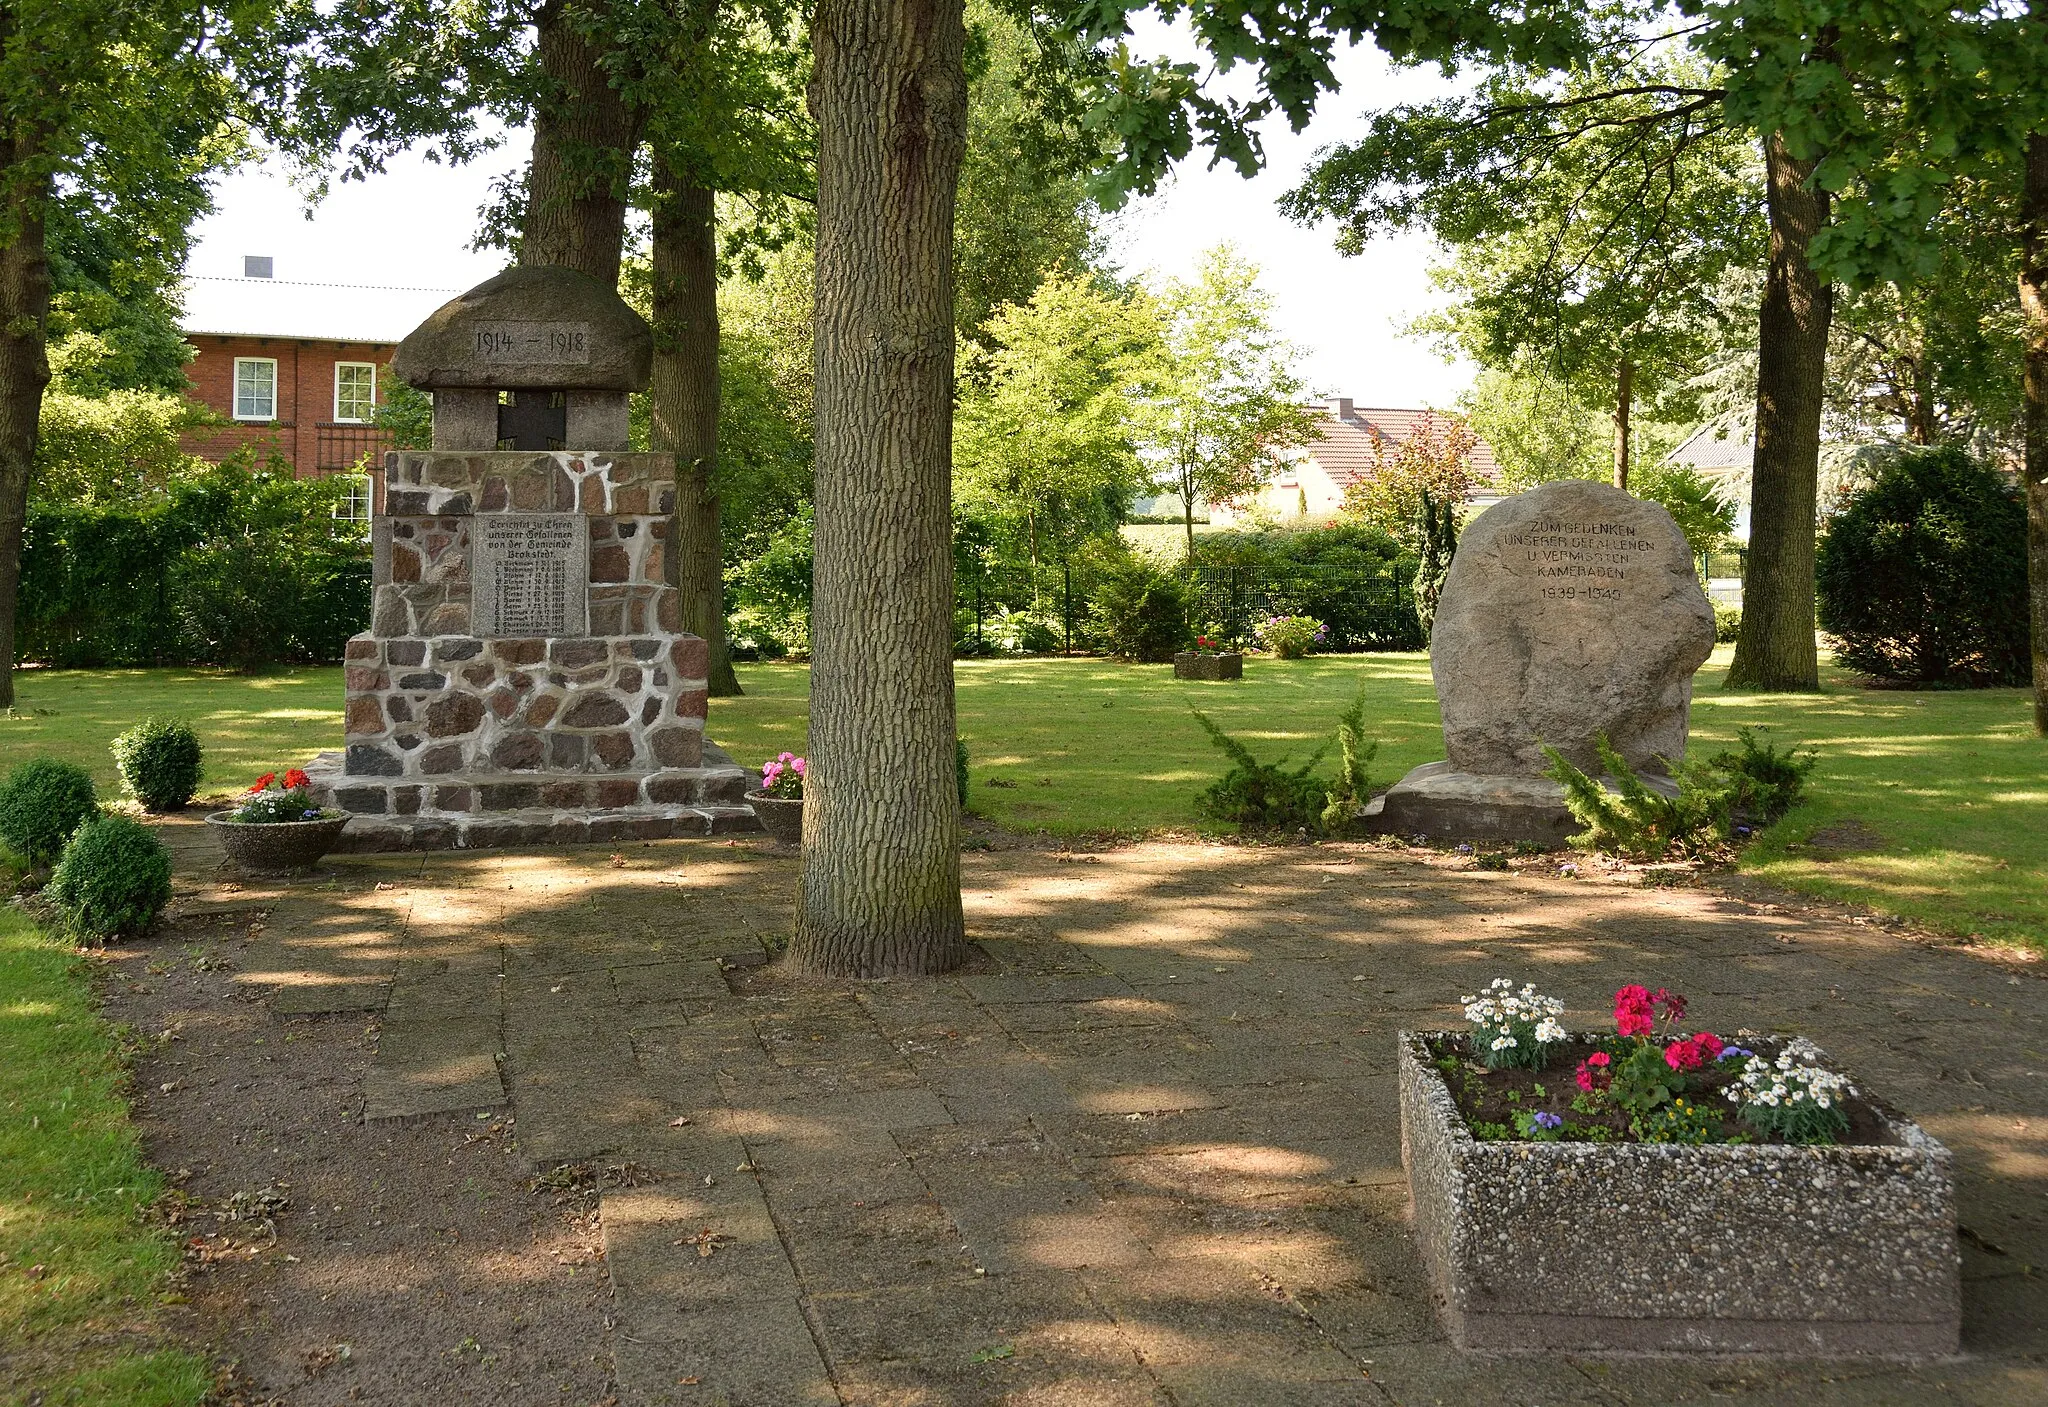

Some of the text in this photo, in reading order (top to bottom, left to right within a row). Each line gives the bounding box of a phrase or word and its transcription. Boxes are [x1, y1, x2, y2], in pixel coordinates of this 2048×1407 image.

[477, 333, 513, 354] 1914
[550, 333, 584, 354] 1918
[533, 522, 542, 530] zu
[545, 520, 572, 529] Ehren
[1530, 521, 1635, 536] ZUM GEDENKEN
[526, 530, 572, 539] Gefallenen
[509, 540, 523, 549] der
[528, 540, 571, 549] Gemeinde
[1504, 535, 1655, 552] UNSERER GEFALLENEN
[1543, 550, 1629, 563] VERMISSTEN
[1537, 566, 1624, 579] KAMERADEN
